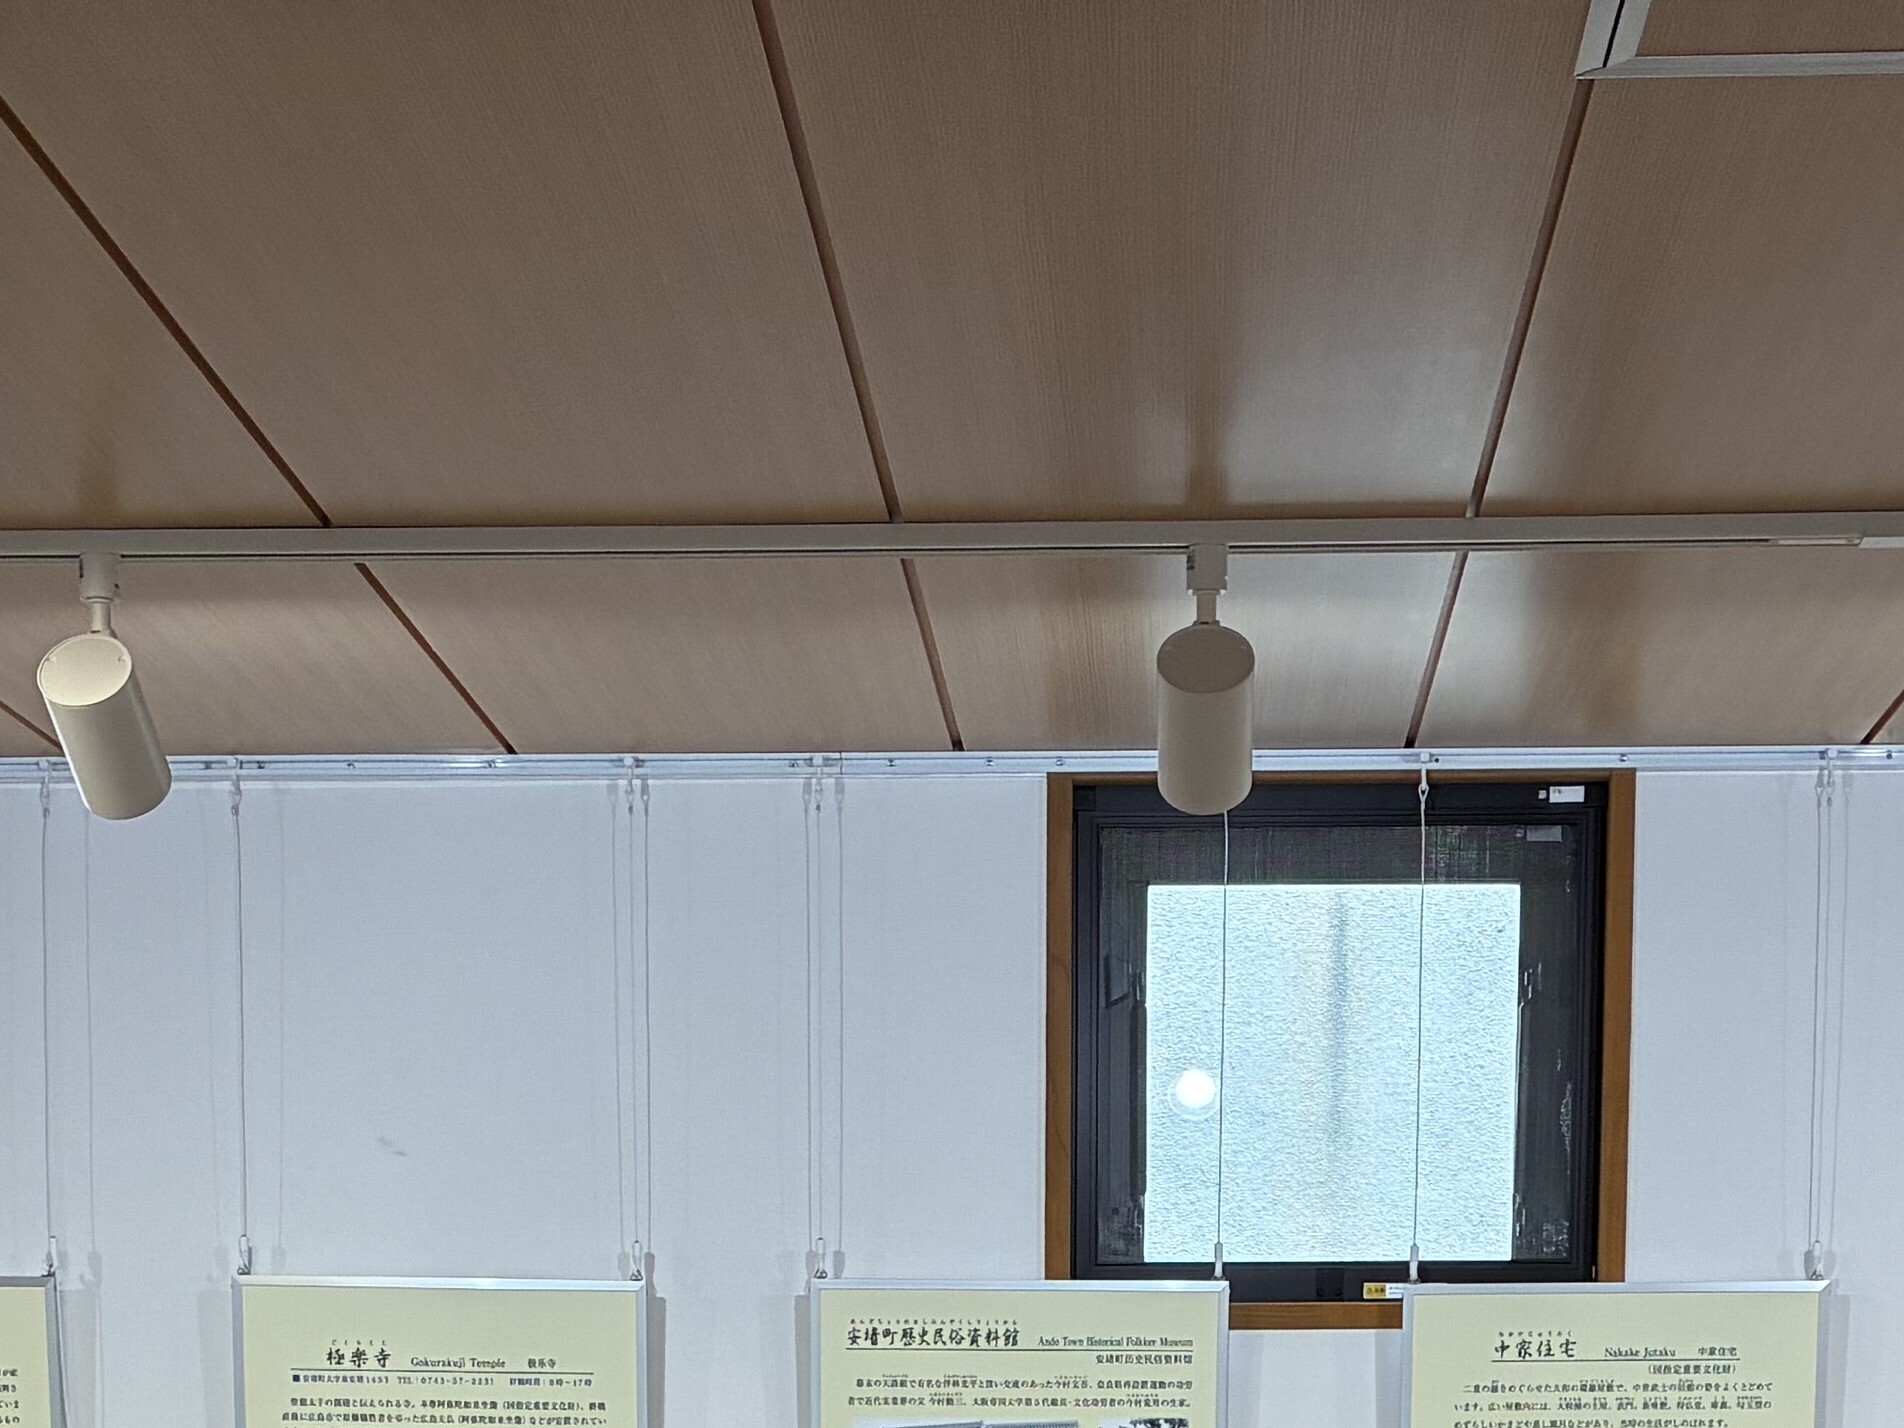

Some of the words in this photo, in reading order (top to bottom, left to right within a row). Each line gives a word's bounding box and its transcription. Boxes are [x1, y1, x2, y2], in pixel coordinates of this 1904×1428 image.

[848, 1328, 1020, 1347] 安堵町歴史民俗資料館
[1038, 1336, 1059, 1347] Ando
[1064, 1337, 1084, 1347] Town
[1087, 1337, 1123, 1347] Historical
[1126, 1336, 1156, 1347] Folklore
[1160, 1337, 1192, 1347] Museum
[326, 1347, 391, 1367] 極楽寺
[411, 1357, 465, 1369] Gokurakuji
[469, 1358, 506, 1369] Temple
[1495, 1339, 1576, 1359] 中家住宅
